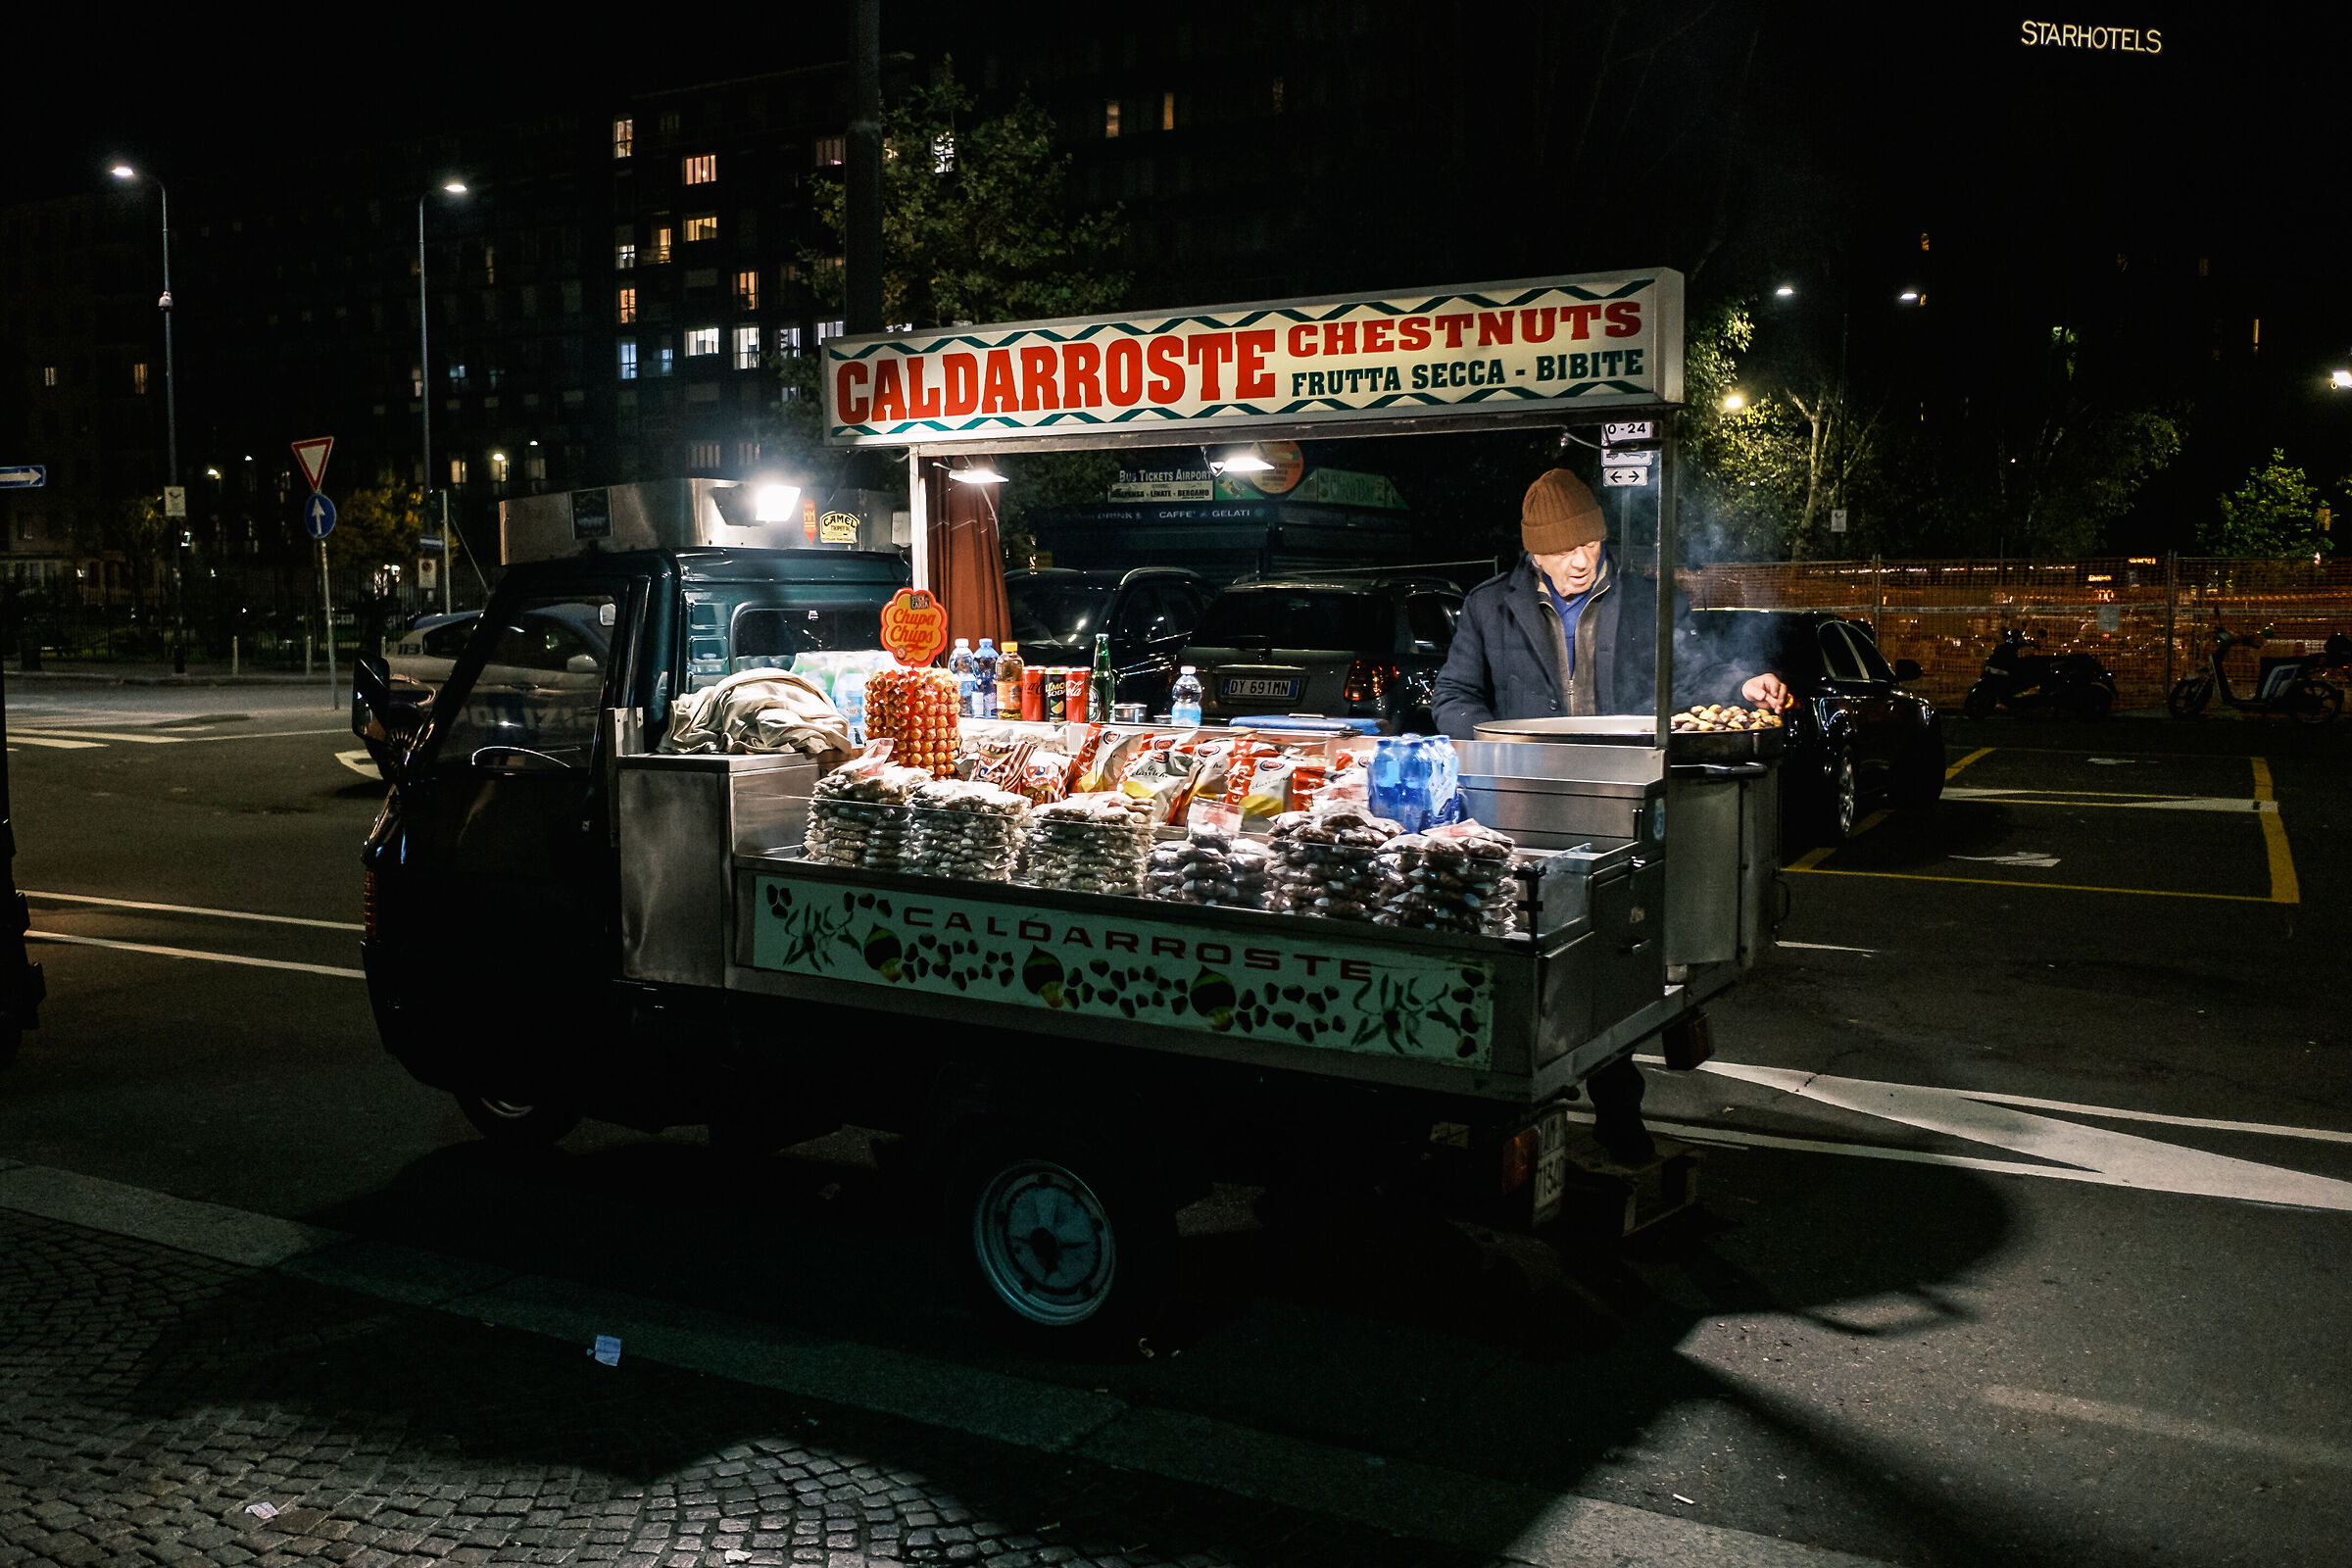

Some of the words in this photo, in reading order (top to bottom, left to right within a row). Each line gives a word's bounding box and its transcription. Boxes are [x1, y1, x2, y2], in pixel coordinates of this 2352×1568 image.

[2021, 20, 2162, 54] STARHOTELS
[1287, 301, 1642, 358] CHESTNUTS
[837, 329, 1276, 424] CALDARROSTE
[1292, 366, 1401, 397] FRUTTA
[1411, 359, 1505, 389] SECCA
[1536, 348, 1643, 382] BIBITE
[1627, 422, 1646, 434] 24
[823, 514, 856, 528] CAMEL
[1211, 510, 1250, 518] GELATI
[893, 608, 937, 629] Chupa
[890, 625, 934, 647] Chups
[1046, 682, 1065, 692] LEMO
[1230, 680, 1247, 694] DY
[904, 906, 1372, 981] CALDARROSTE
